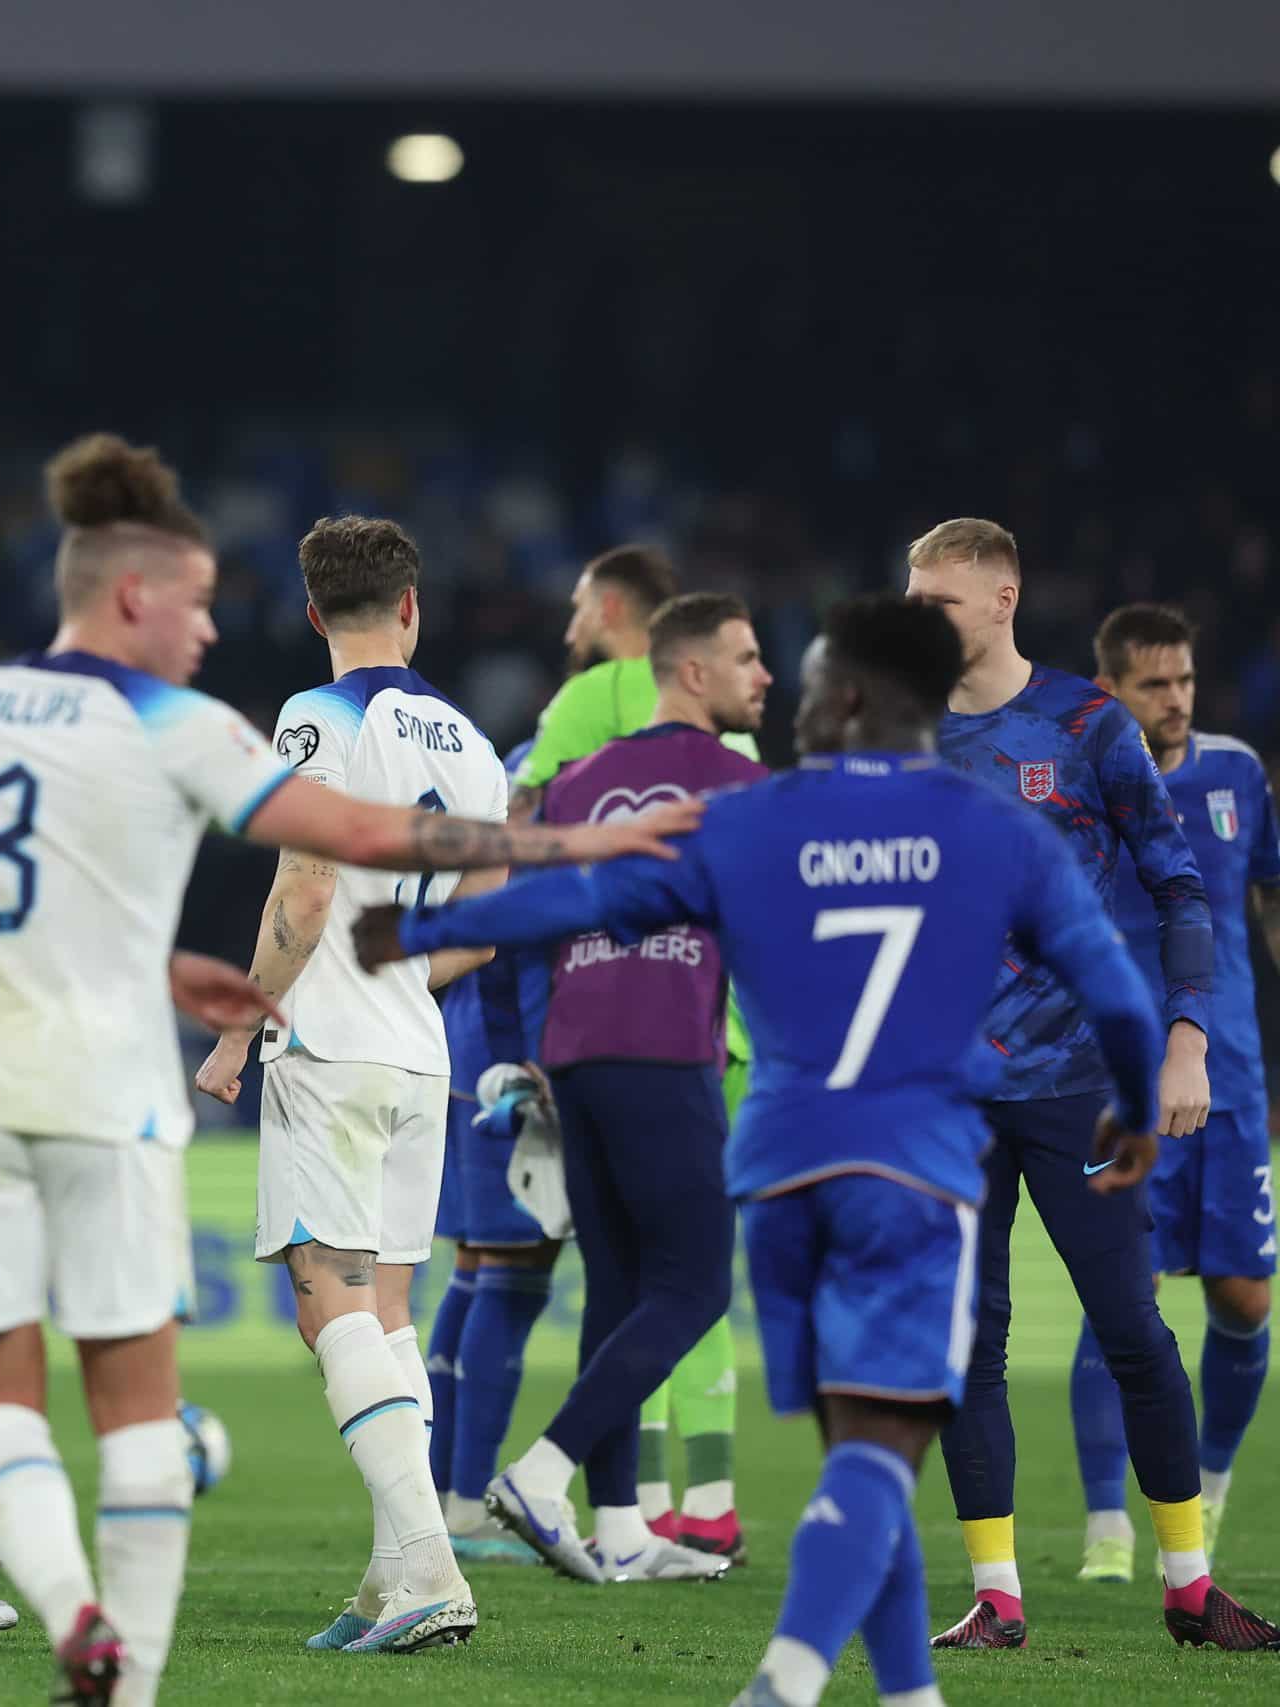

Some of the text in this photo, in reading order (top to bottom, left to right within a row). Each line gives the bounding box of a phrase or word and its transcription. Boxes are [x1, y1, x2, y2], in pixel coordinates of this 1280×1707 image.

[394, 708, 463, 753] STONES
[799, 836, 941, 888] GNONTO
[812, 905, 926, 1090] 7
[1253, 1165, 1276, 1225] 3
